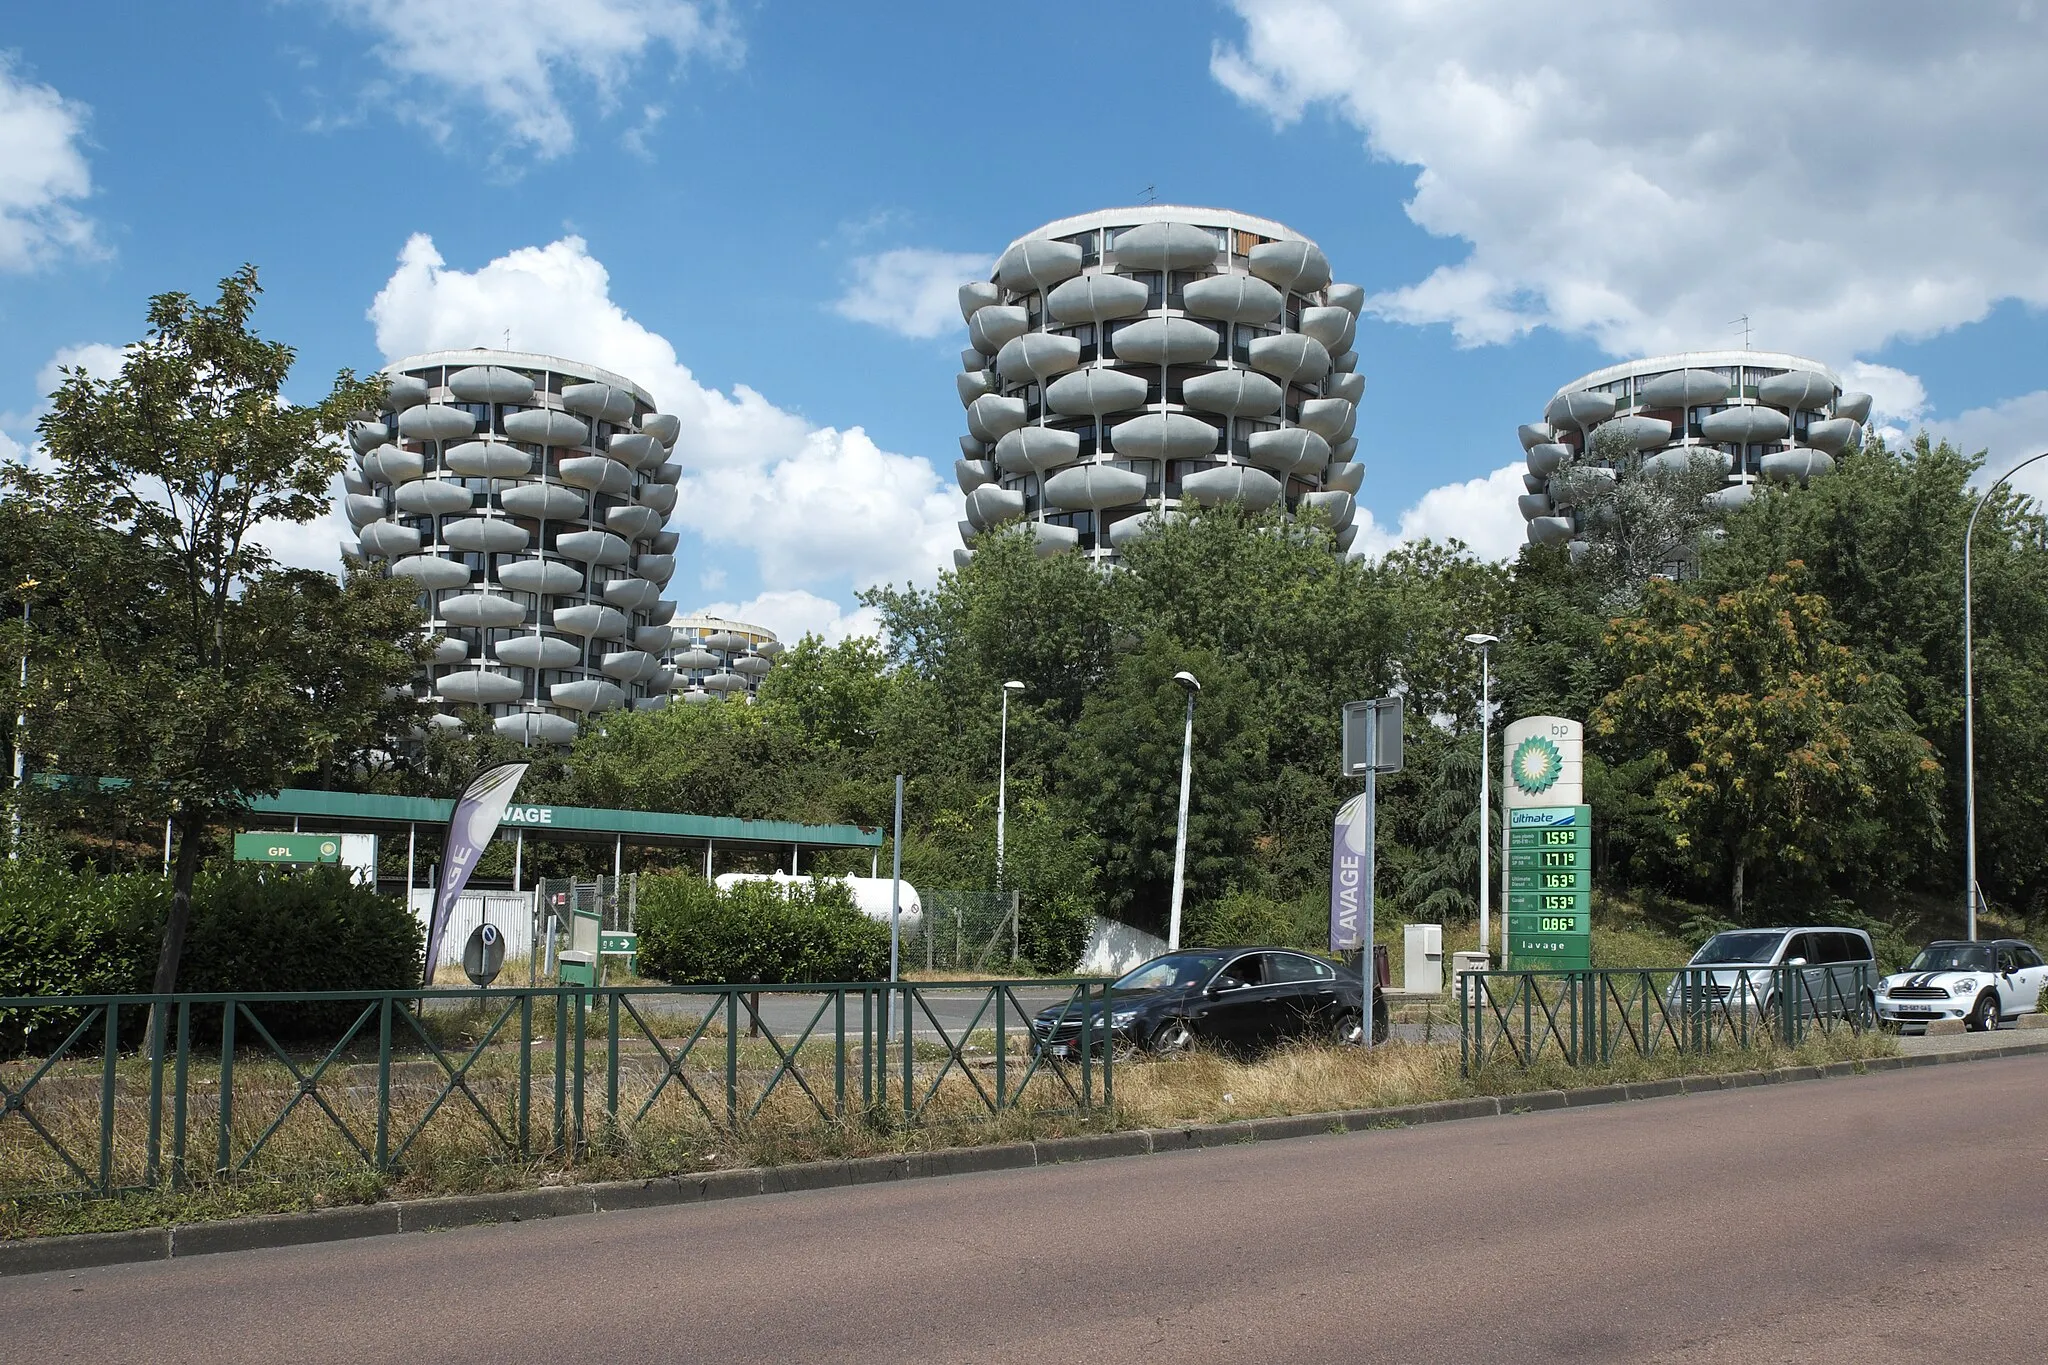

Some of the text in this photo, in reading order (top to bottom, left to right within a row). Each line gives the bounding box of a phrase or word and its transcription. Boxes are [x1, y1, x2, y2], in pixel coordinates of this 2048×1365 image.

[1552, 724, 1568, 738] bp
[502, 807, 552, 824] VAGE
[1512, 813, 1554, 824] ultimate
[268, 847, 292, 857] GPL
[1339, 855, 1359, 944] LAVAGE
[1522, 940, 1565, 951] lavage
